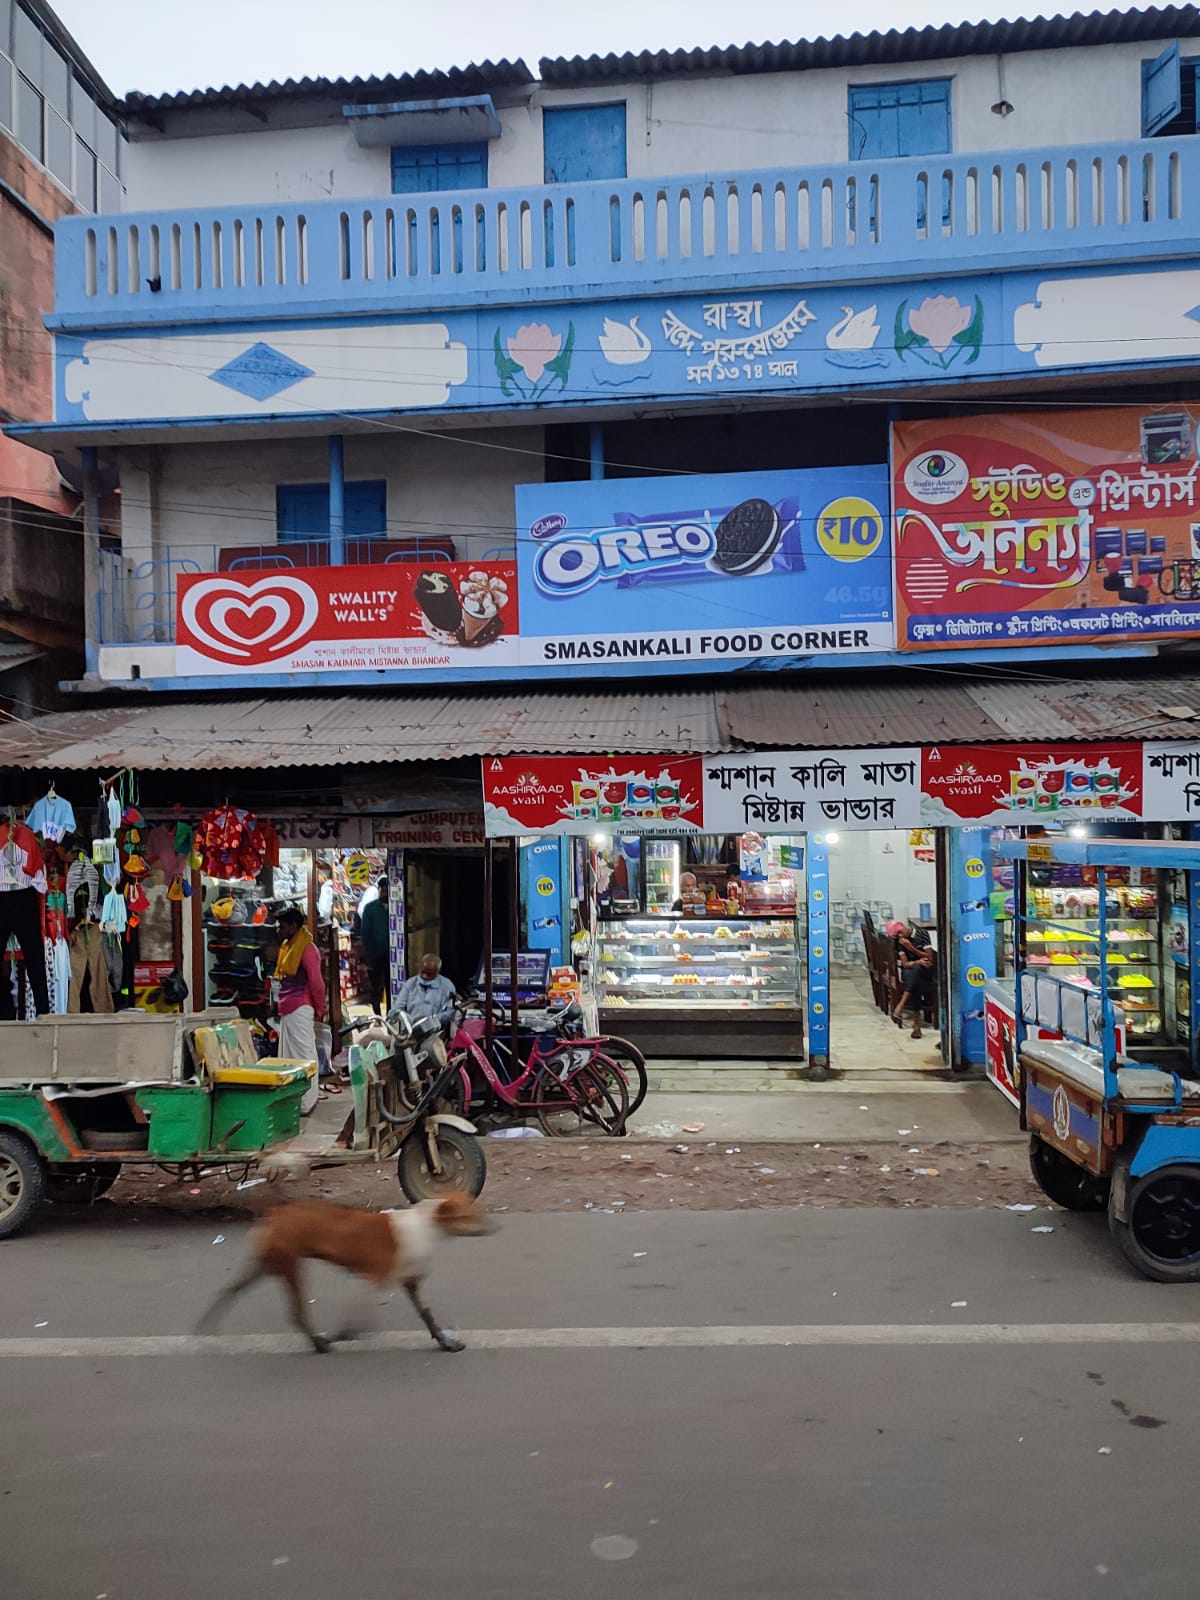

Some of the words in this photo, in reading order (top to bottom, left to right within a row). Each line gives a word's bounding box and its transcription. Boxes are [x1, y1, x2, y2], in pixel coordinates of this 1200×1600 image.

[768, 361, 798, 376] সাল
[970, 463, 1067, 520] স্টুডিও
[1096, 462, 1199, 512] প্রিন্টার্স
[822, 515, 878, 545] ₹10
[542, 524, 711, 585] OREO
[897, 508, 1095, 591] অনন্যা
[328, 591, 398, 606] KWALITY
[543, 637, 692, 660] SMASANKALI
[699, 633, 764, 655] FOOD
[770, 629, 870, 651] CORNER
[291, 660, 325, 670] SMASAN
[706, 765, 777, 790] শ্মশান
[789, 758, 847, 790] কালি
[860, 760, 917, 787] মাতা
[928, 774, 1002, 785] AASHIRVAAD
[492, 784, 565, 795] AASHIRVAAD
[948, 784, 982, 795] svasti
[742, 792, 806, 825] মিষ্টান্ন
[375, 830, 443, 844] TRAINING
